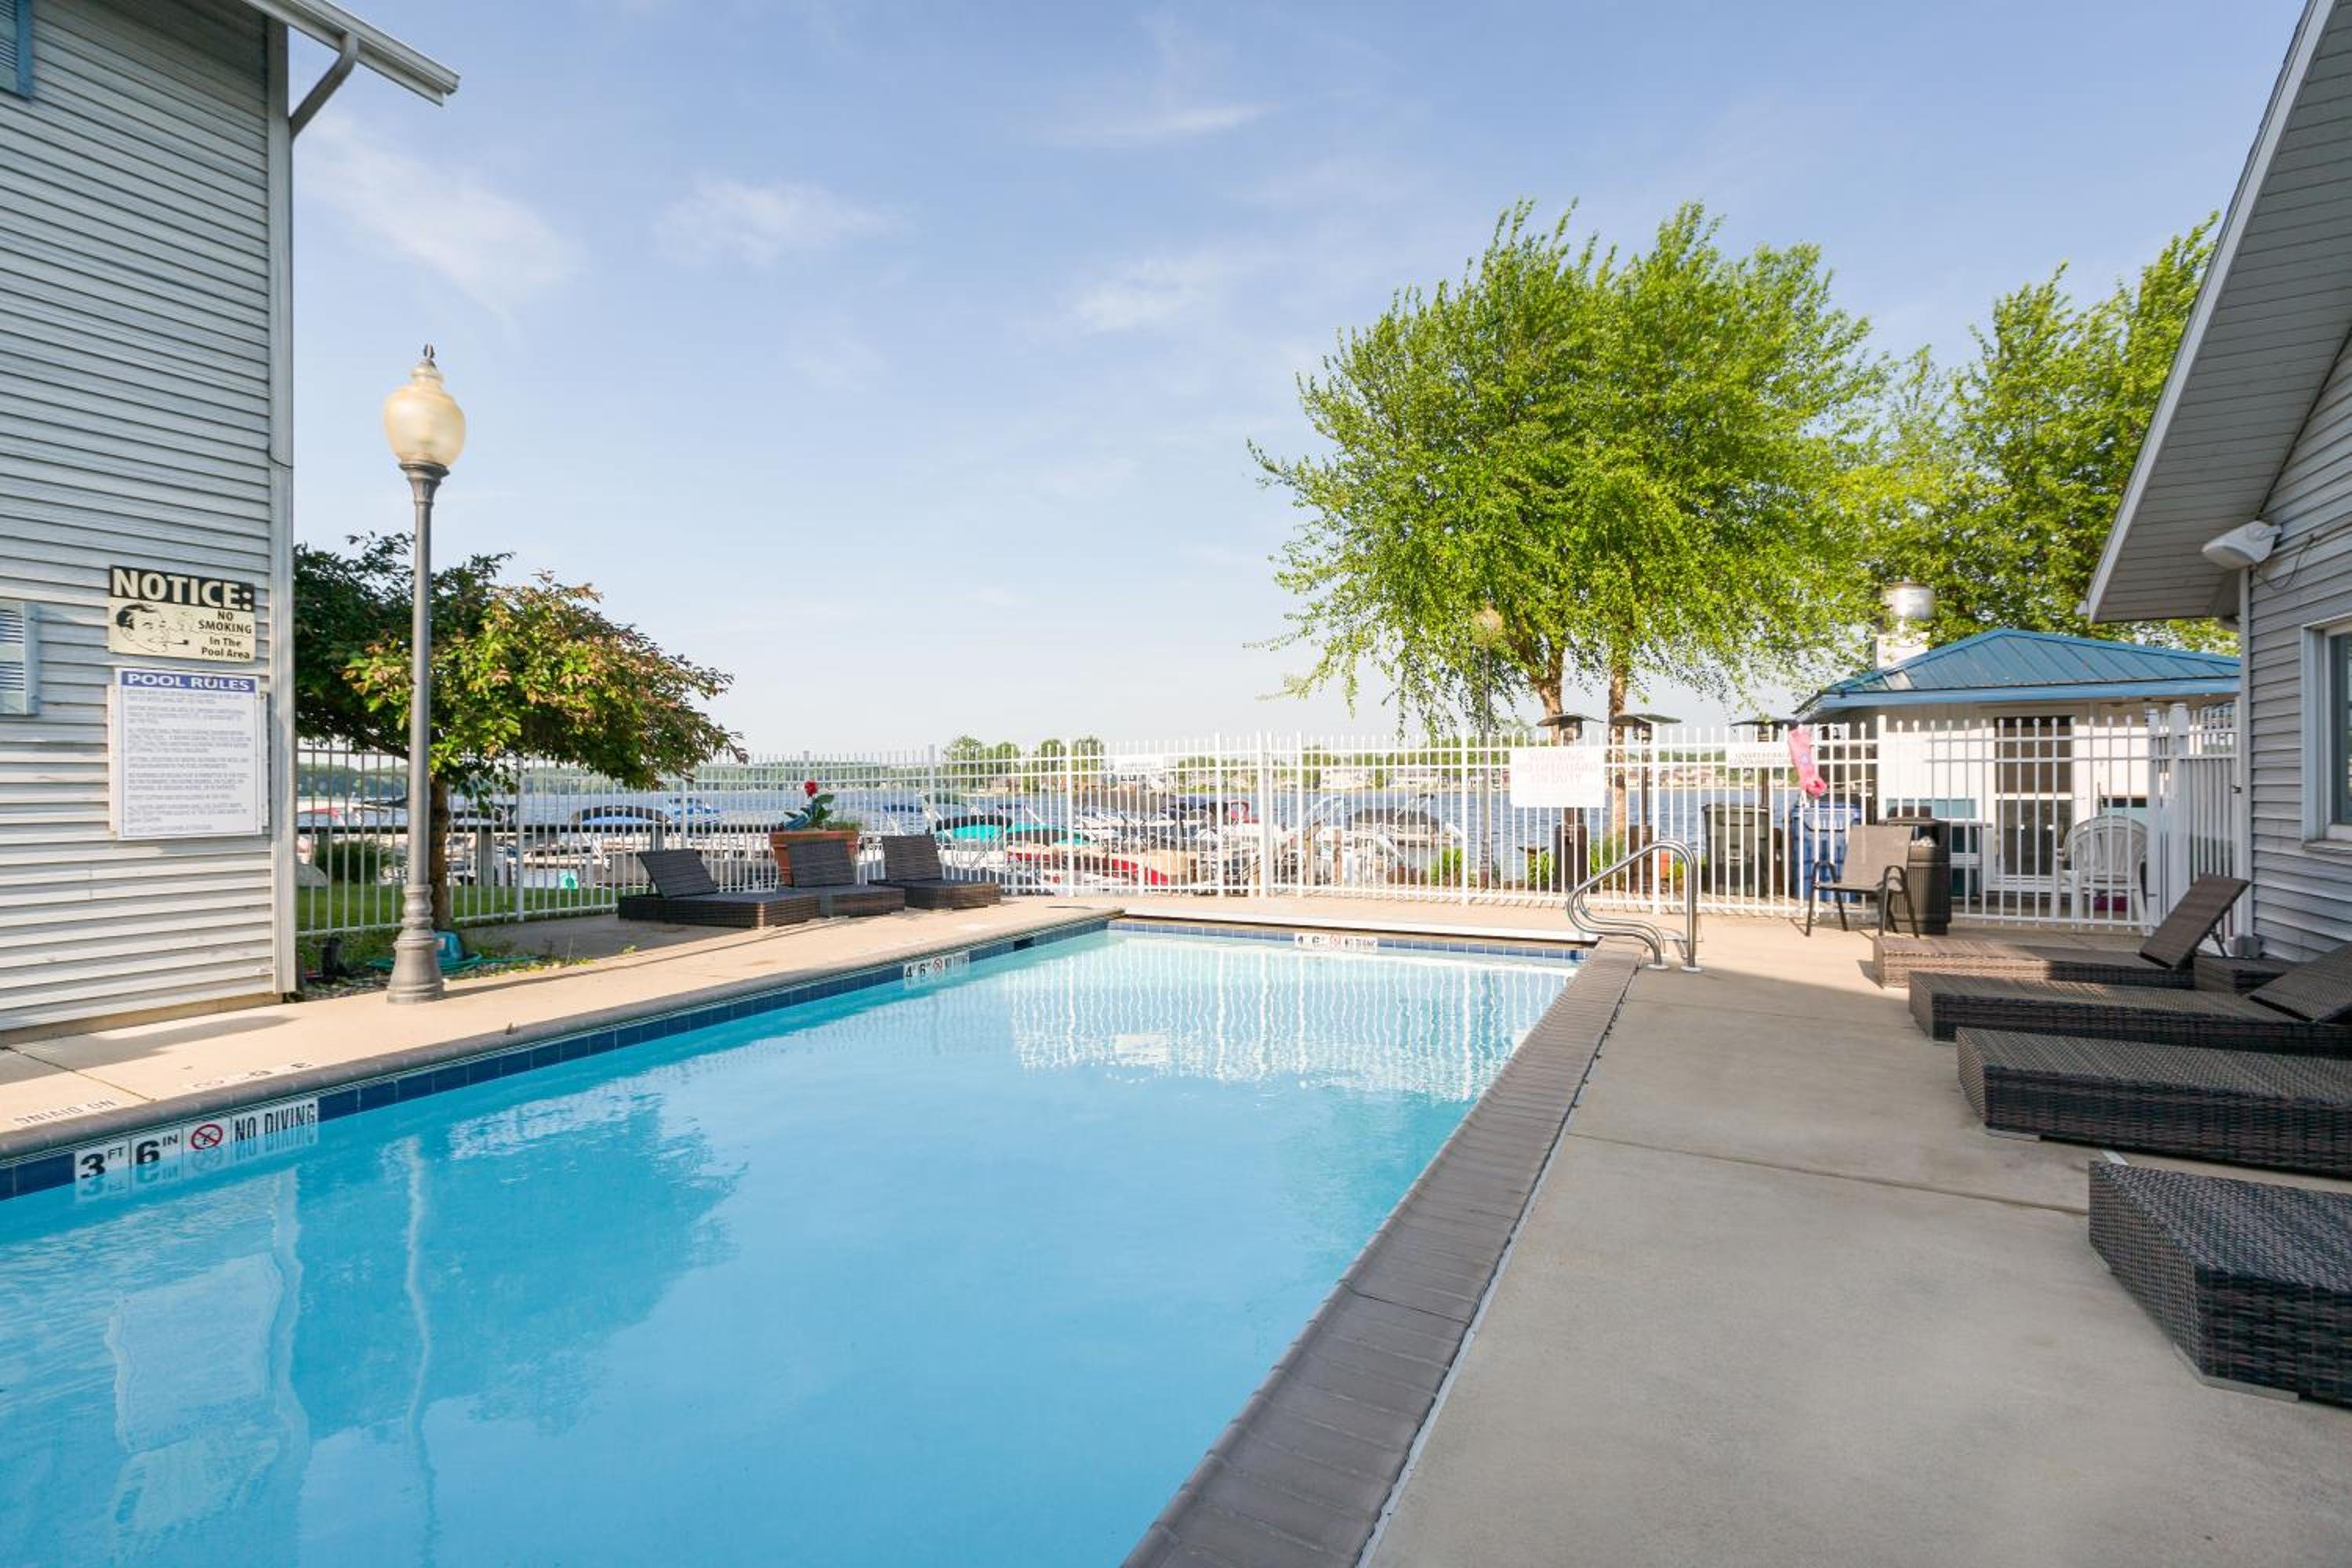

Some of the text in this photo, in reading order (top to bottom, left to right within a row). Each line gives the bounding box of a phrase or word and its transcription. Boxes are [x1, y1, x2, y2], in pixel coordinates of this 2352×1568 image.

[113, 568, 252, 610] NOTICE:
[217, 611, 234, 620] NO
[198, 619, 252, 634] SMOKING
[210, 637, 241, 647] In The
[201, 647, 250, 659] Pool Area
[127, 673, 250, 691] POOL RULES
[906, 965, 913, 978] 4
[79, 1103, 316, 1178] 3 FT 6 IN NO DIVING
